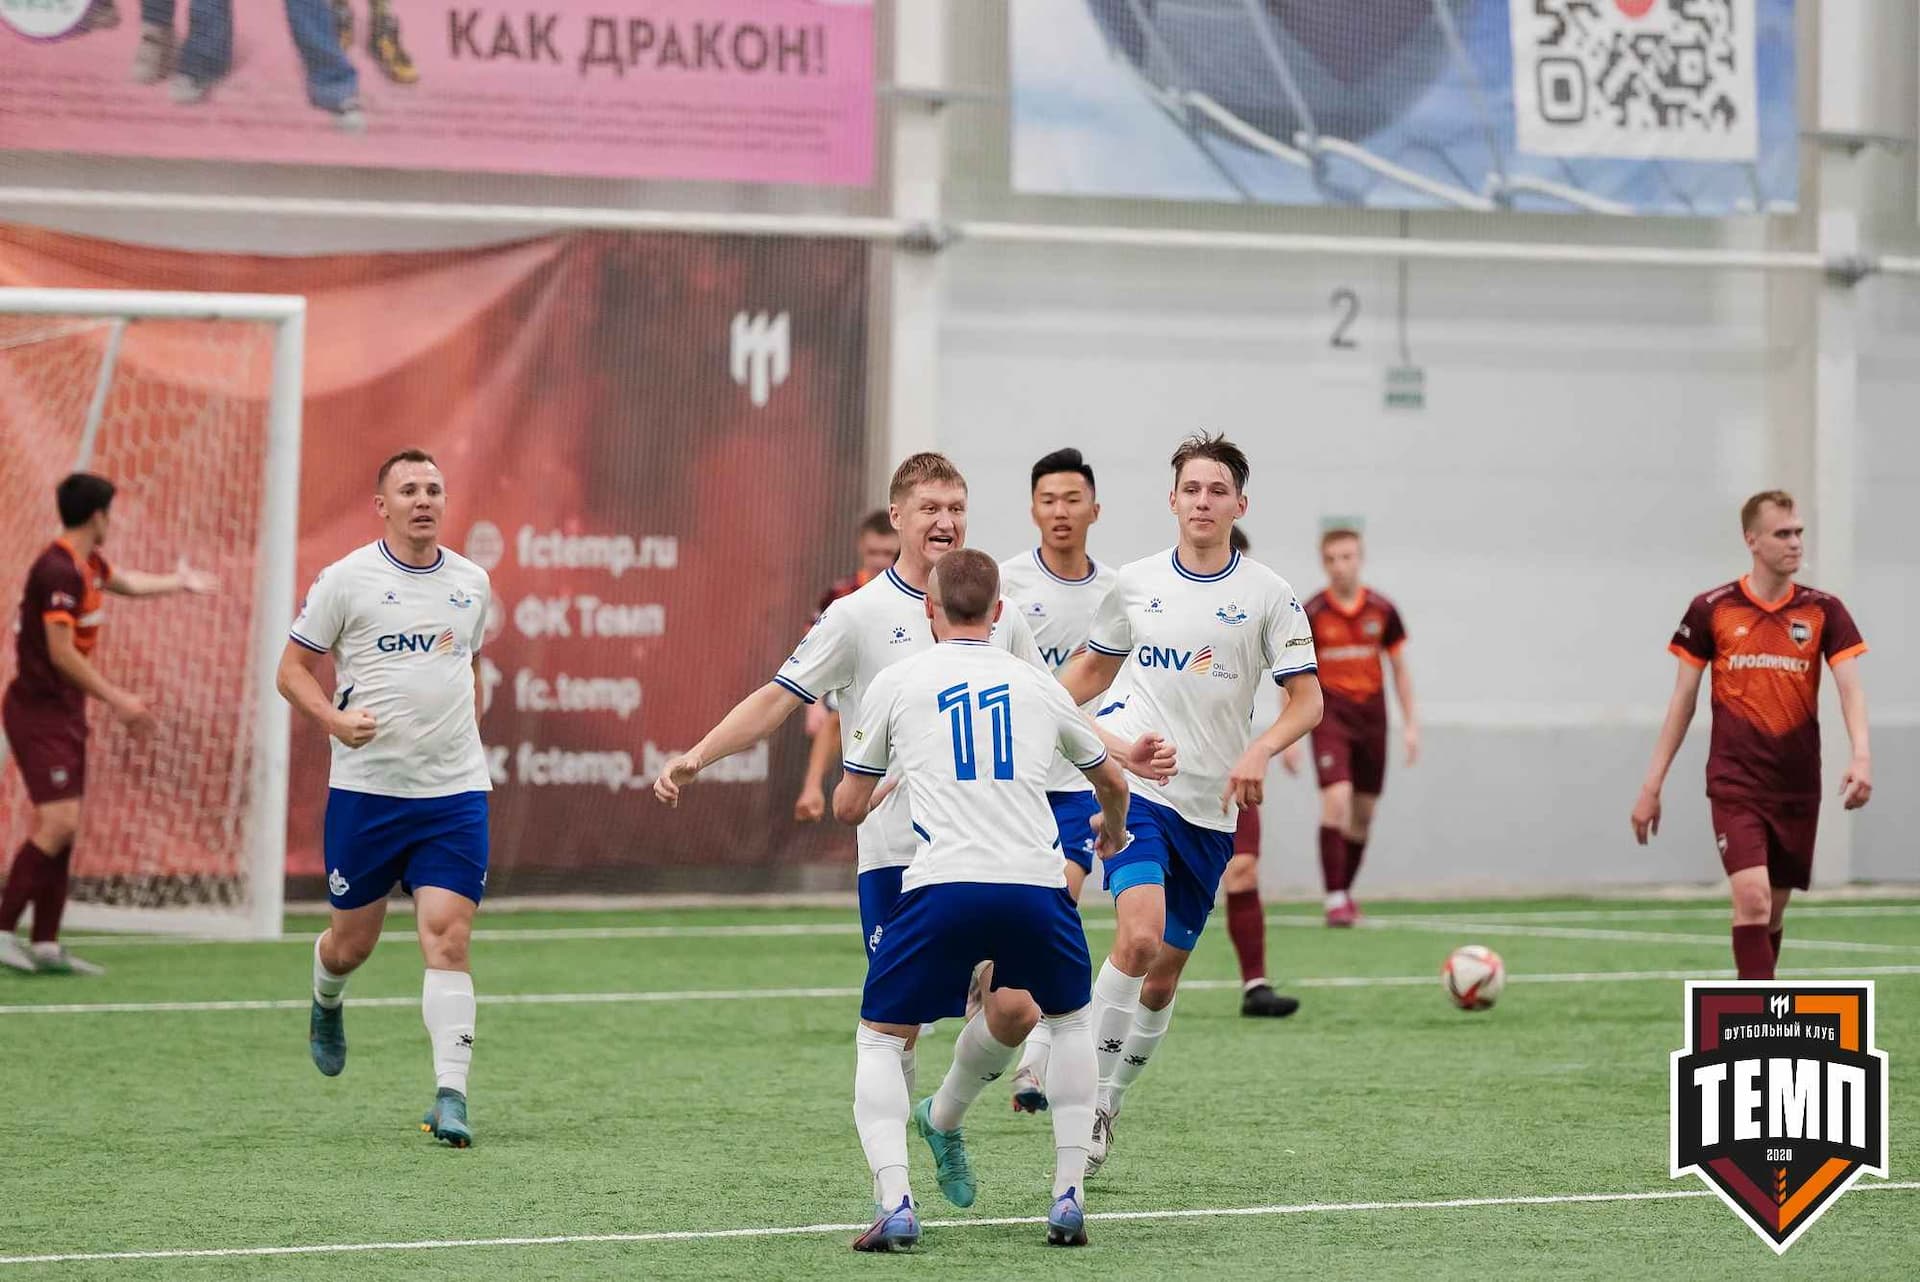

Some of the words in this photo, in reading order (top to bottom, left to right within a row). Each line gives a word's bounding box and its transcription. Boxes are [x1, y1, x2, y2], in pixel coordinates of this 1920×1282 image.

[448, 9, 562, 63] КАК
[578, 16, 827, 79] ДРАКОН!
[1329, 286, 1362, 350] 2
[516, 525, 678, 577] fctemp.ru
[377, 633, 436, 652] GNV
[514, 596, 573, 638] ФК
[575, 596, 666, 637] Темп
[1038, 646, 1070, 666] NV
[1138, 645, 1191, 671] GNV
[515, 667, 642, 718] fc.temp
[936, 681, 1015, 781] 11
